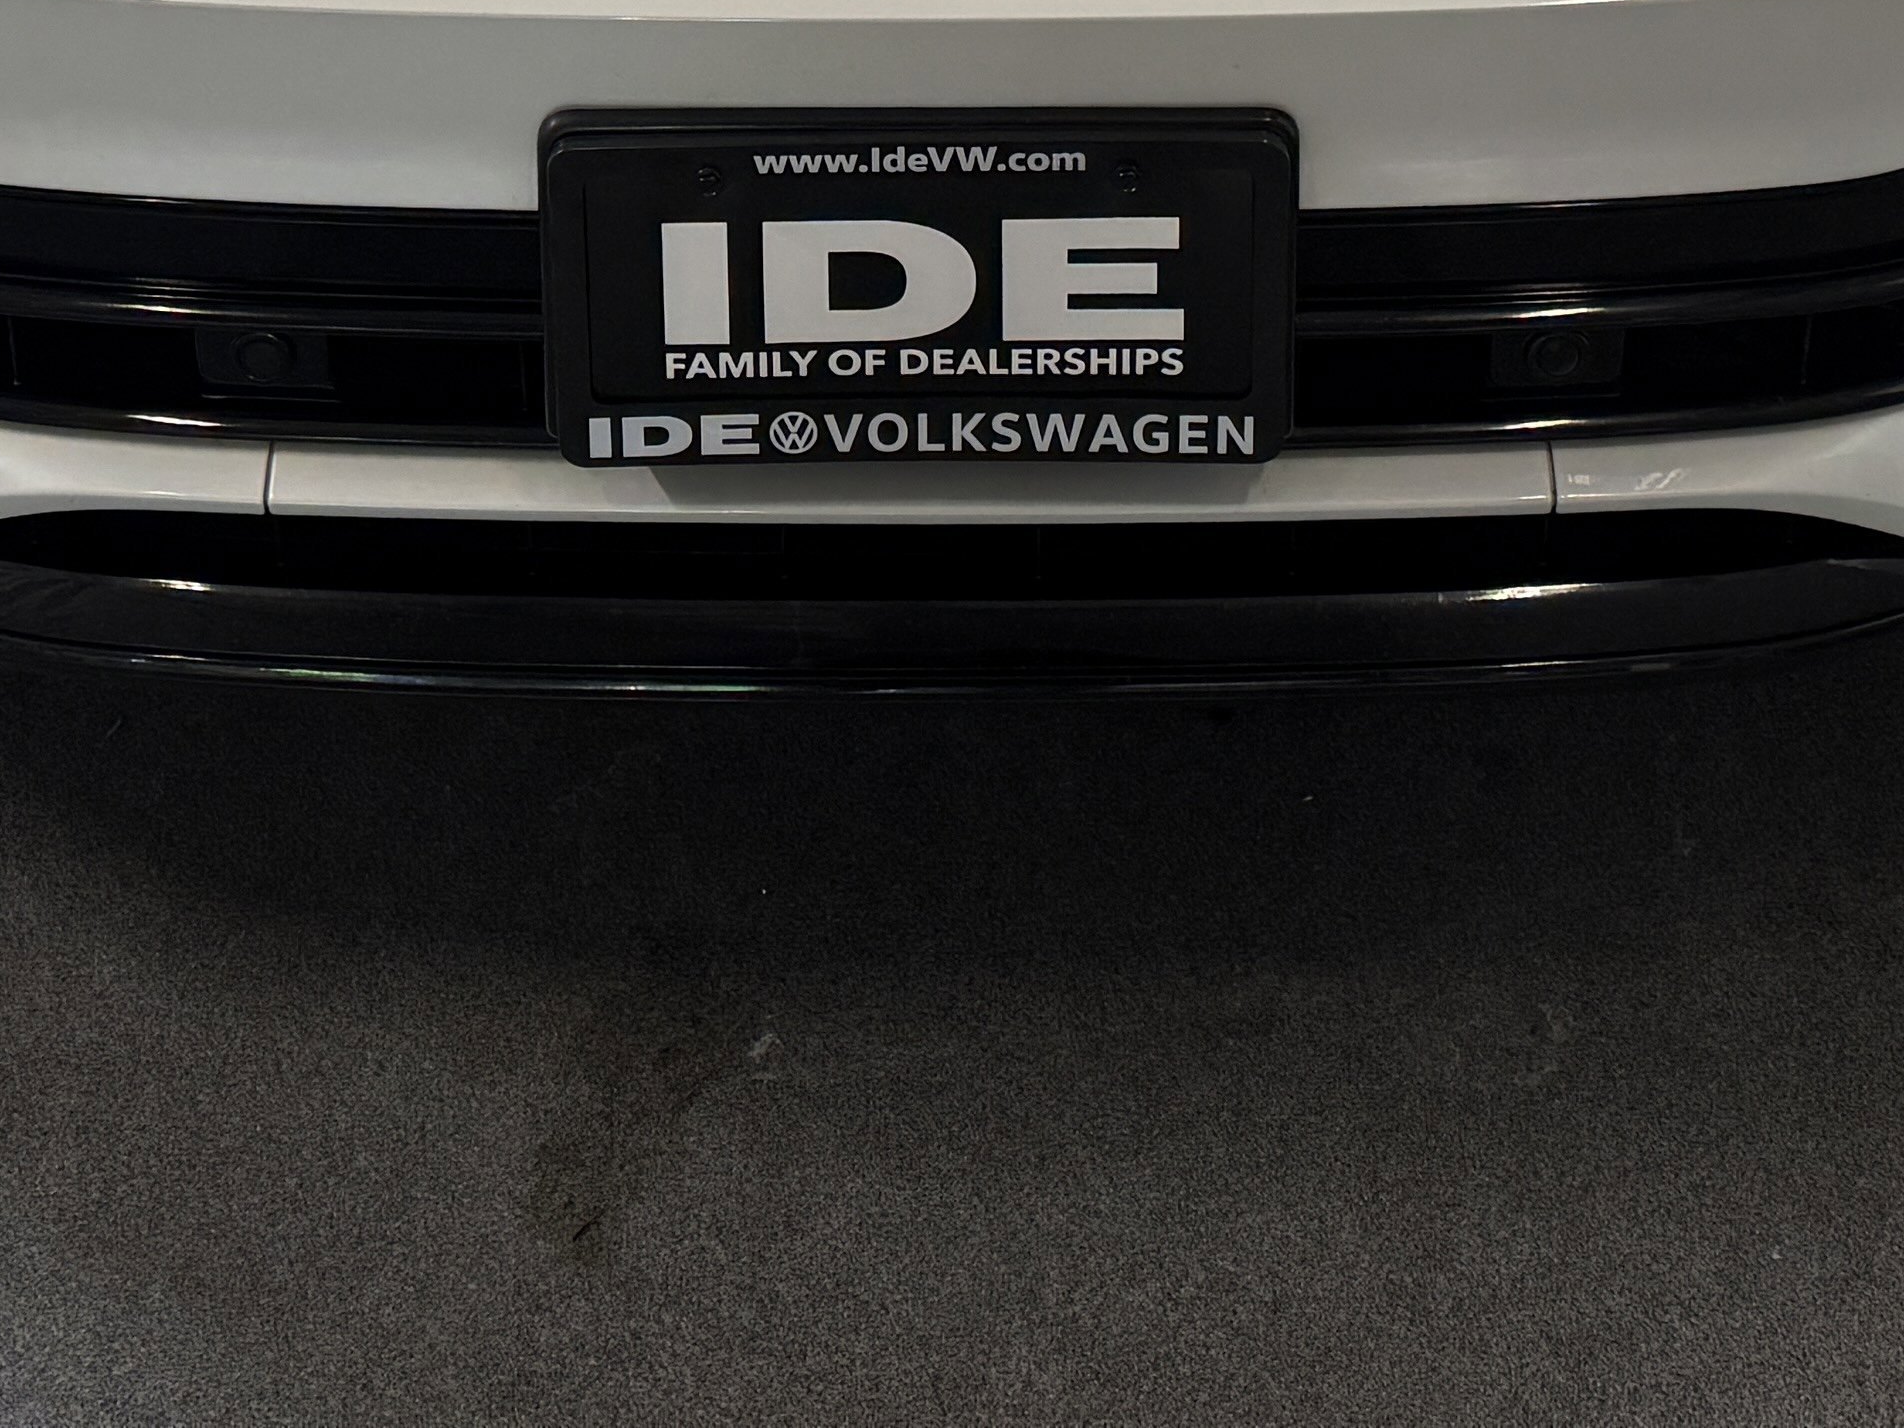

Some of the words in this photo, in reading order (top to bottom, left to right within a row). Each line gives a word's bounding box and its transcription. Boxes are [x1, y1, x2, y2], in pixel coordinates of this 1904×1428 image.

[753, 145, 1087, 175] www.IdeVW.com
[661, 217, 1185, 345] IDE
[664, 350, 818, 380] FAMILY
[829, 349, 885, 376] OF
[899, 347, 1185, 377] DEALERSHIPS
[588, 413, 761, 459] IDE
[823, 412, 1255, 455] VOLKSWAGEN
